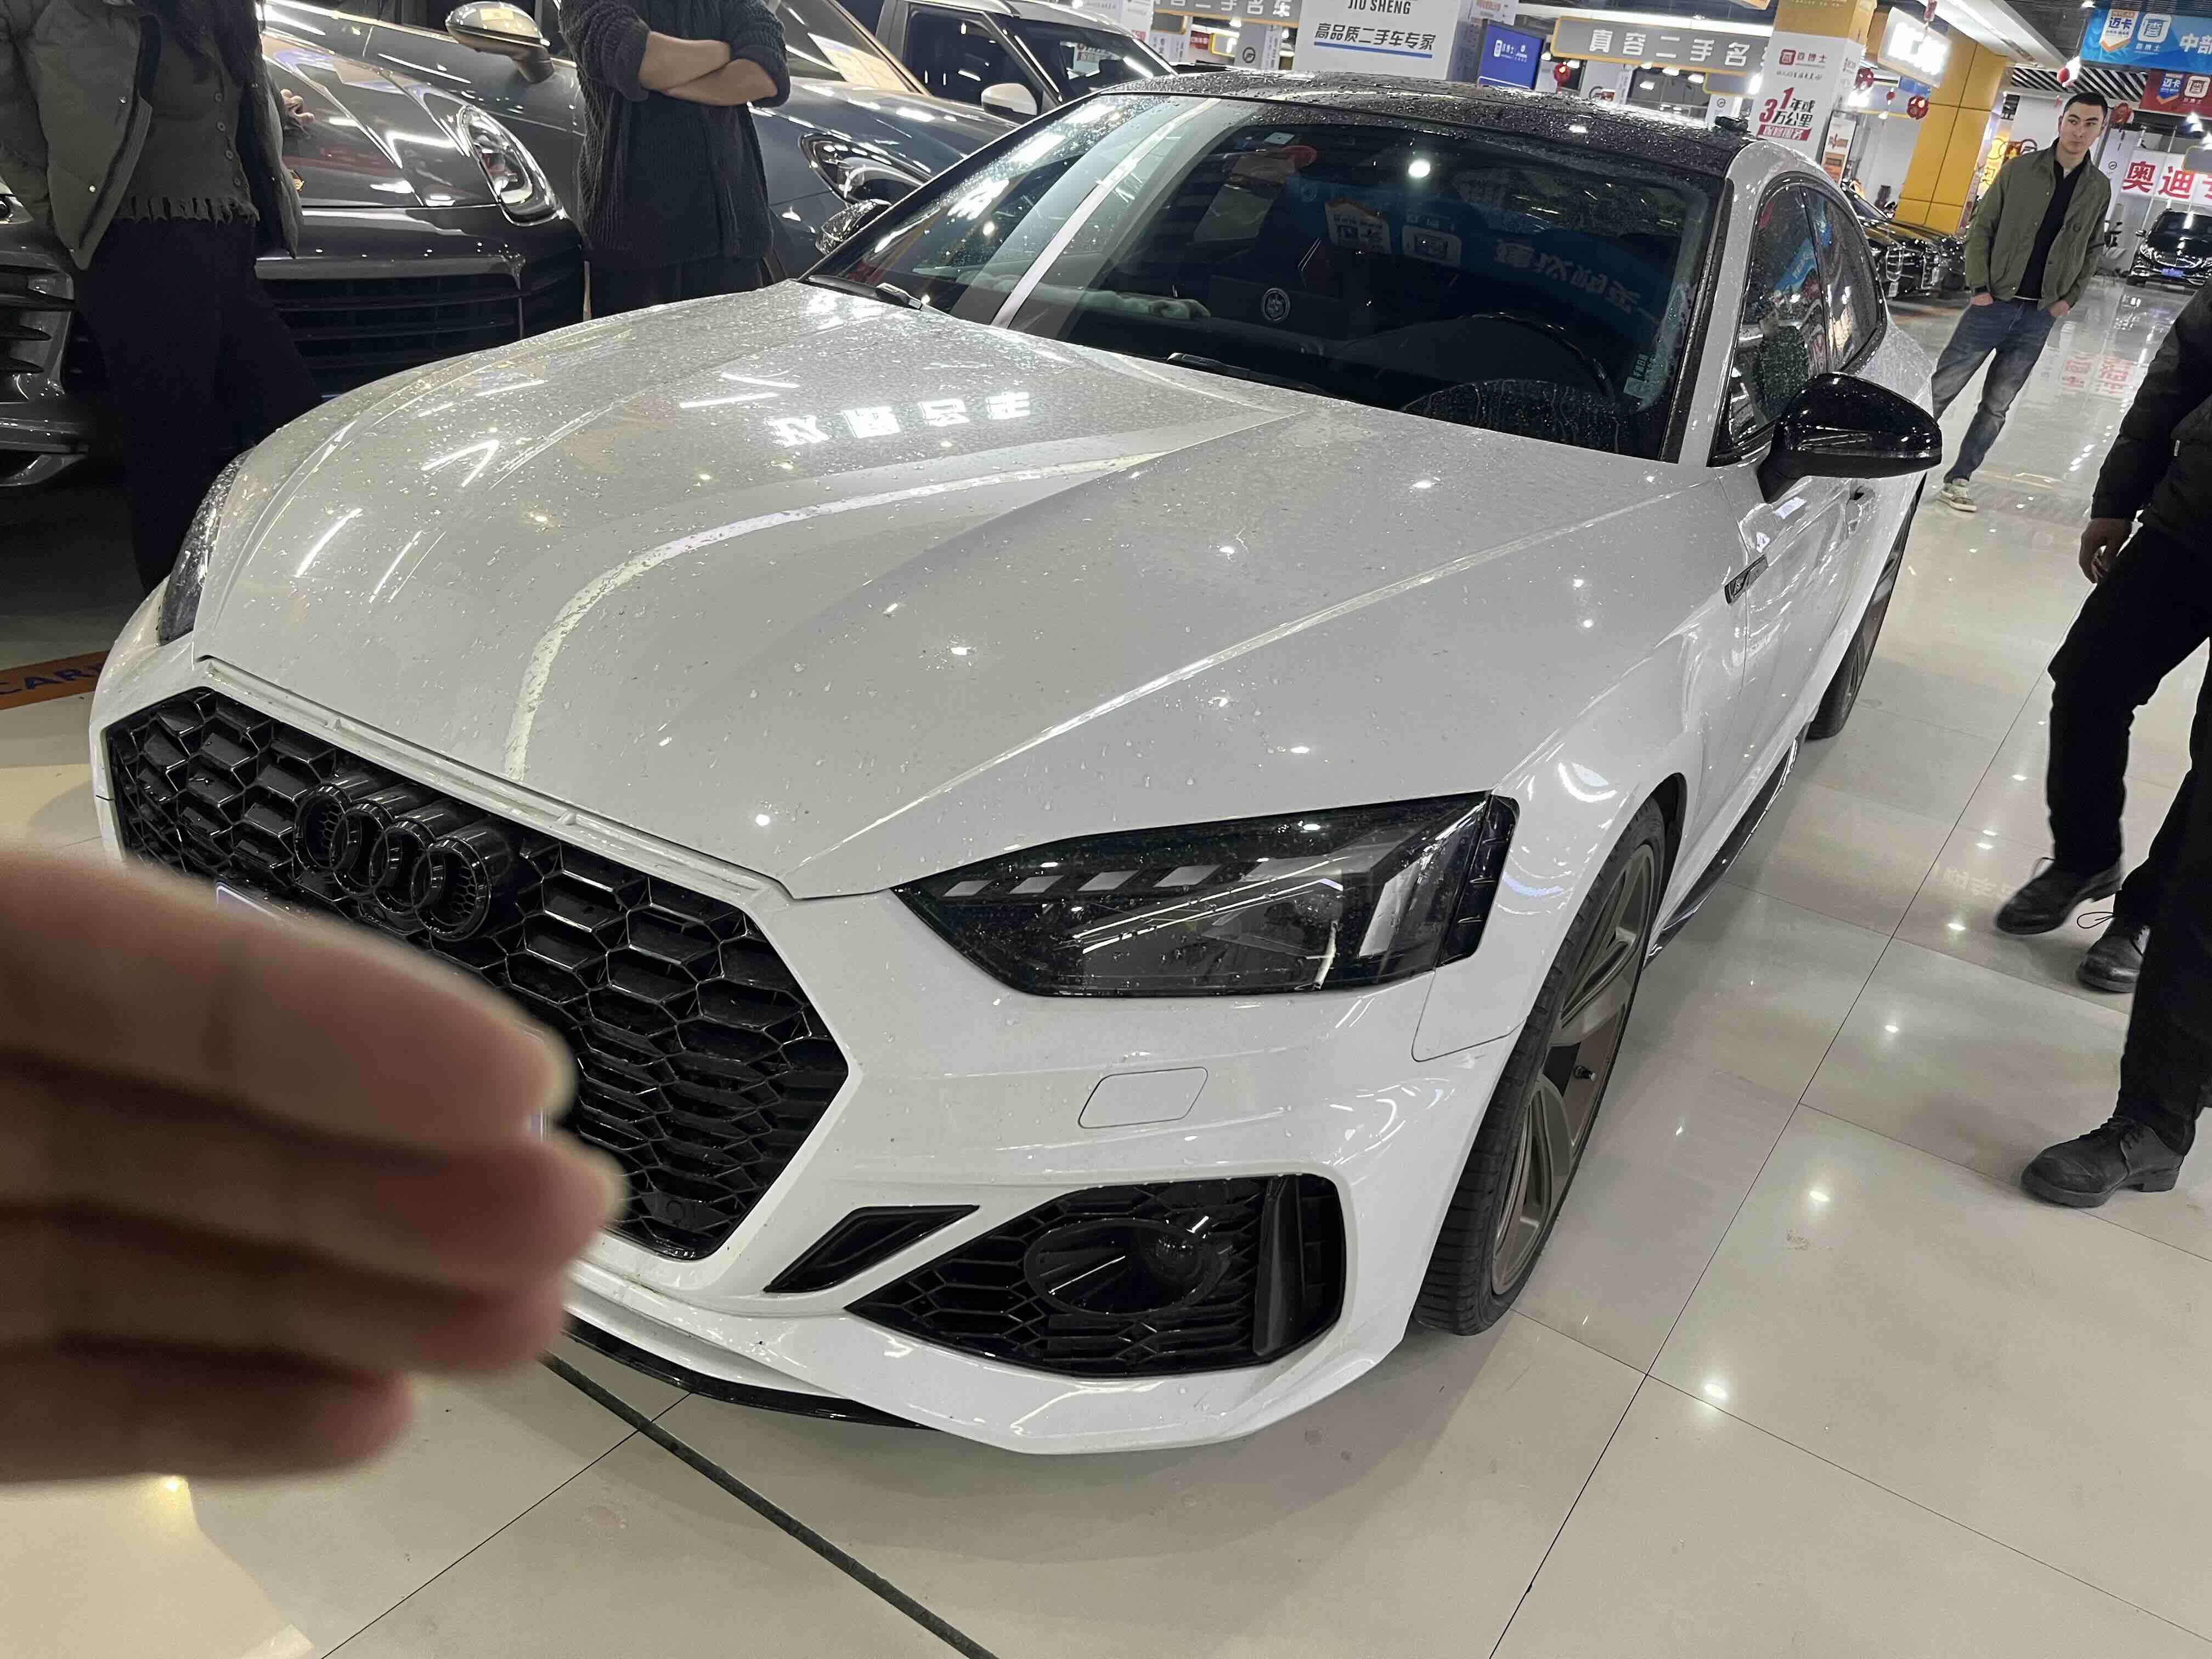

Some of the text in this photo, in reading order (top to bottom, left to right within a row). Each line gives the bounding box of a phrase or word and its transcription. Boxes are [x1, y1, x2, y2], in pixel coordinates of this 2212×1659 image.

[1369, 0, 1412, 15] SHENG
[1314, 22, 1436, 51] 高品质二手车专家
[1589, 29, 1768, 67] 真容二手名
